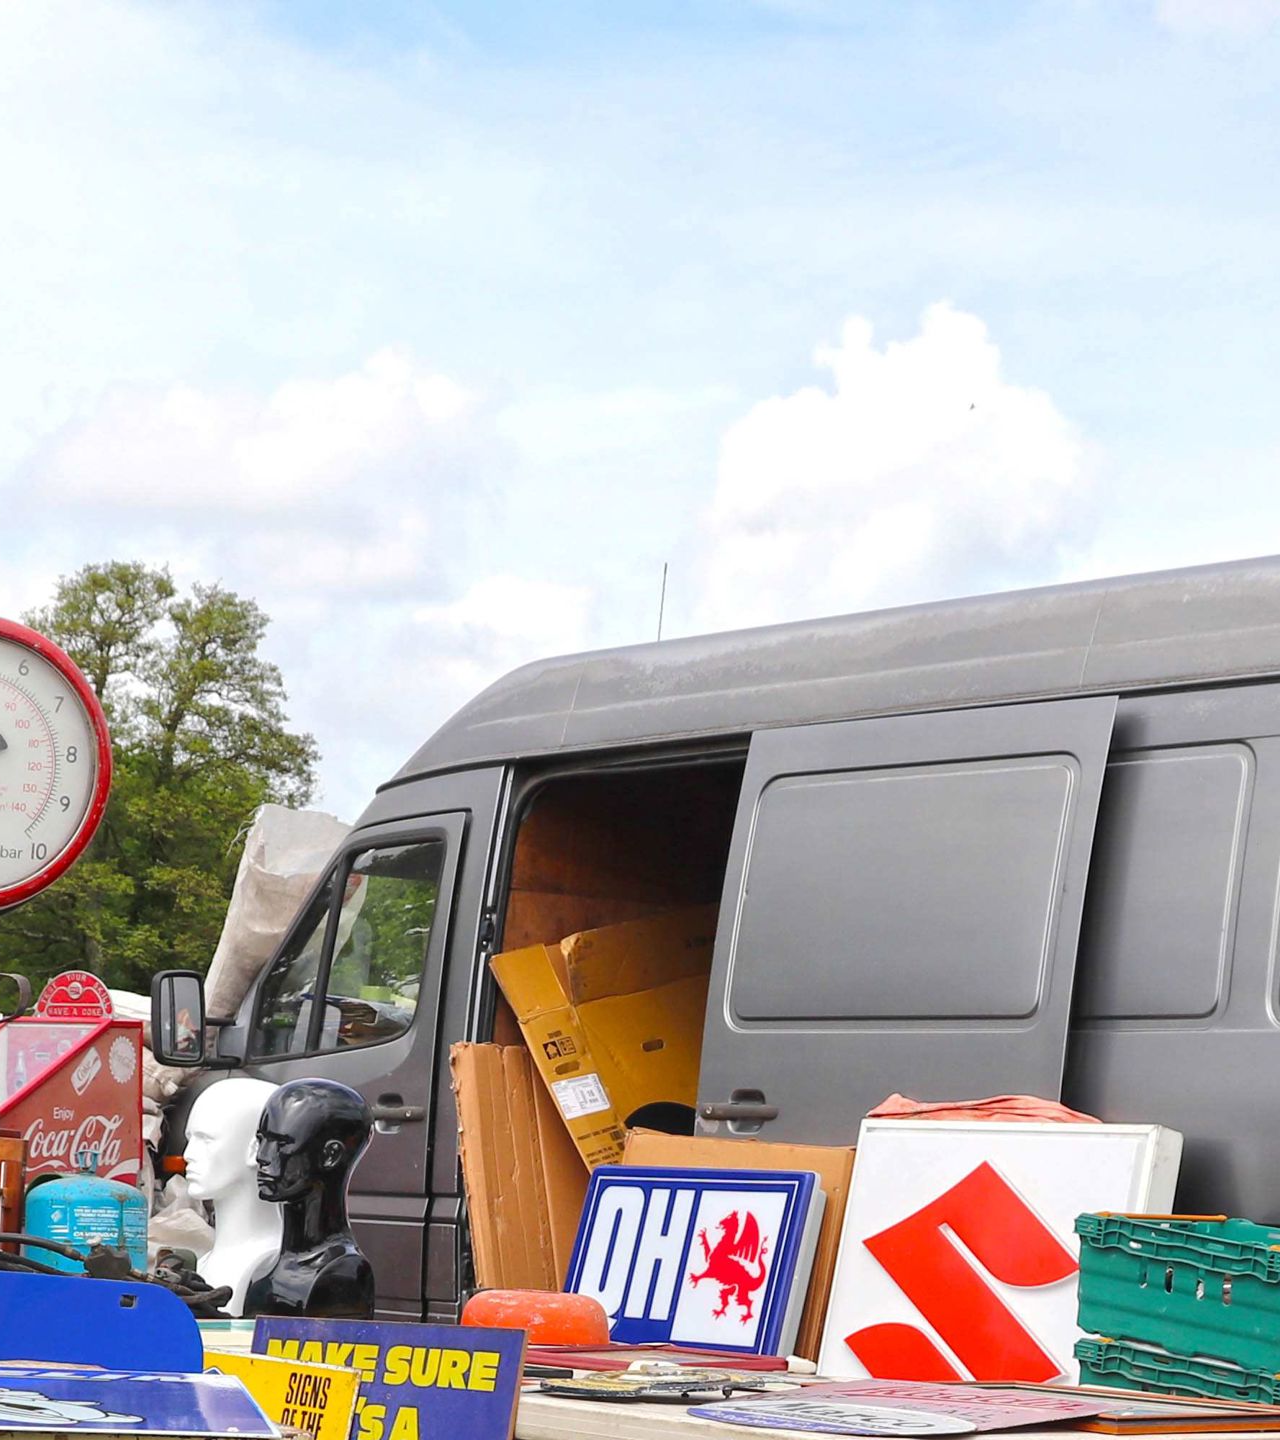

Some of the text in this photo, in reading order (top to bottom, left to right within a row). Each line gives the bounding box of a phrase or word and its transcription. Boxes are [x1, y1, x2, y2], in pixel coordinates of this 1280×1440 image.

[19, 659, 29, 676] 6
[4, 702, 17, 713] 90
[54, 696, 65, 713] 7
[15, 719, 30, 730] 100
[66, 746, 77, 763] 8
[27, 762, 42, 773] 120
[22, 783, 37, 794] 130
[59, 796, 70, 812] 9
[0, 845, 23, 859] bar
[30, 843, 47, 860] 10
[66, 973, 87, 982] YOUR
[72, 1007, 78, 1016] A
[53, 1107, 75, 1121] Enjoy
[24, 1114, 123, 1172] Coca-Cola
[578, 1185, 697, 1330] QH
[384, 1344, 500, 1392] SURE
[285, 1372, 331, 1410] SIGNS
